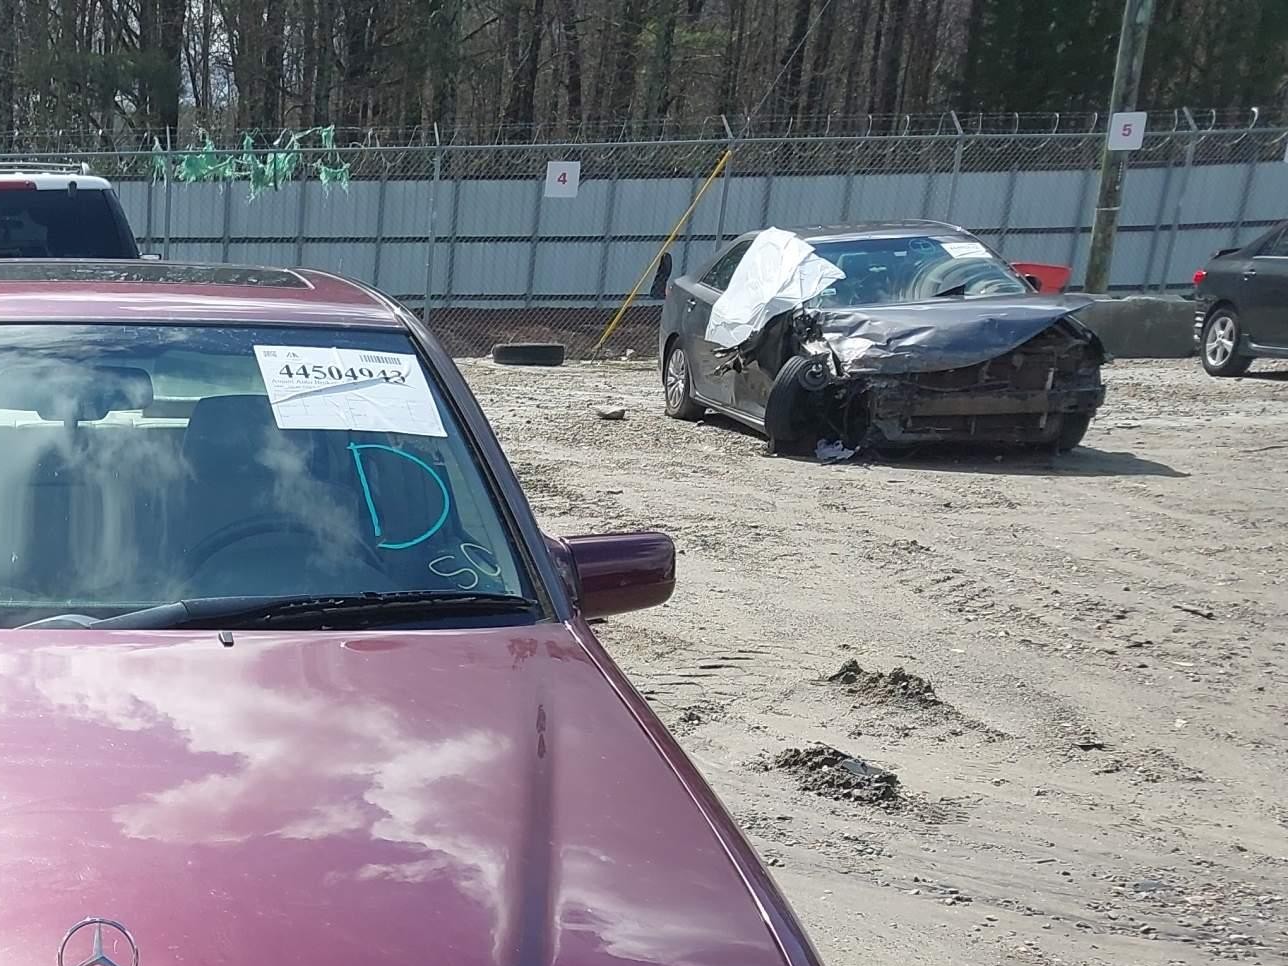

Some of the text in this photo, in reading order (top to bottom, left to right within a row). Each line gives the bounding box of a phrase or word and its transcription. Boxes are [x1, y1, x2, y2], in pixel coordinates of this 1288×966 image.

[1122, 124, 1132, 136] 5
[557, 172, 568, 184] 4
[347, 442, 450, 549] D
